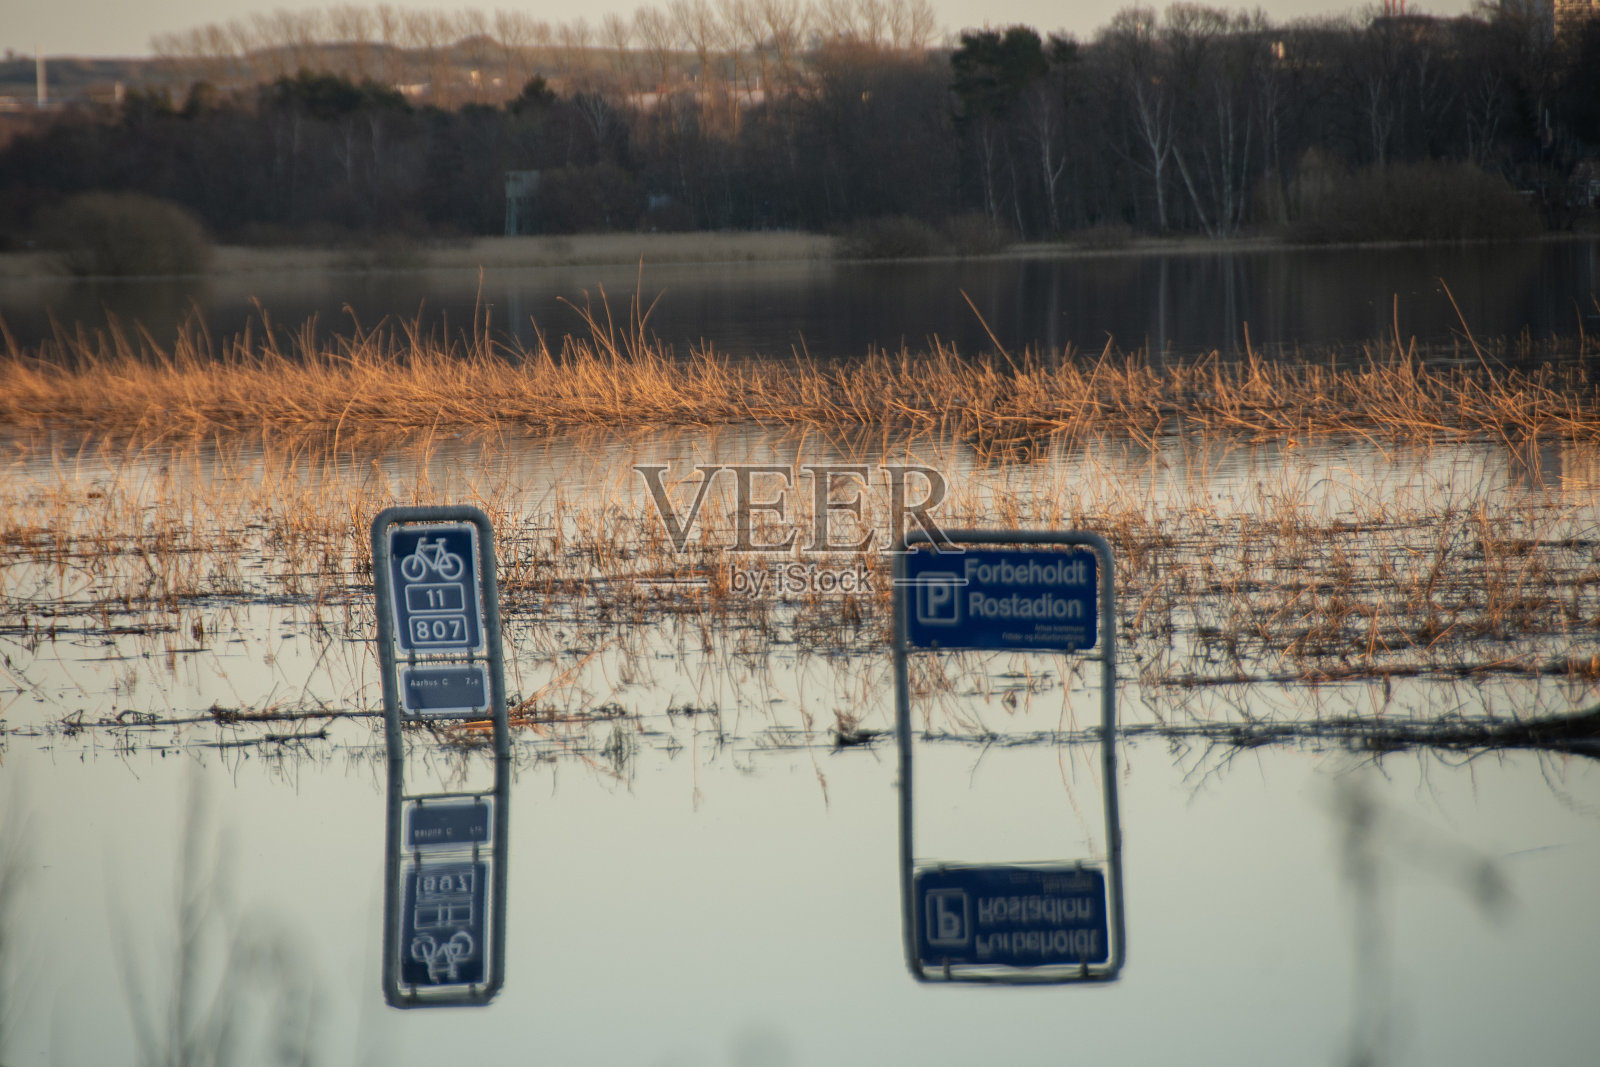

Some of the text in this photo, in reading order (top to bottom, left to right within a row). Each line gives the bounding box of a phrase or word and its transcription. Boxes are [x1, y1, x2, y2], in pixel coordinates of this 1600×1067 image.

[963, 558, 1087, 585] Forbeholdt
[426, 588, 445, 608] 11
[927, 579, 950, 617] P
[968, 592, 1082, 618] Rostadion
[416, 620, 461, 639] 807
[442, 678, 449, 686] C
